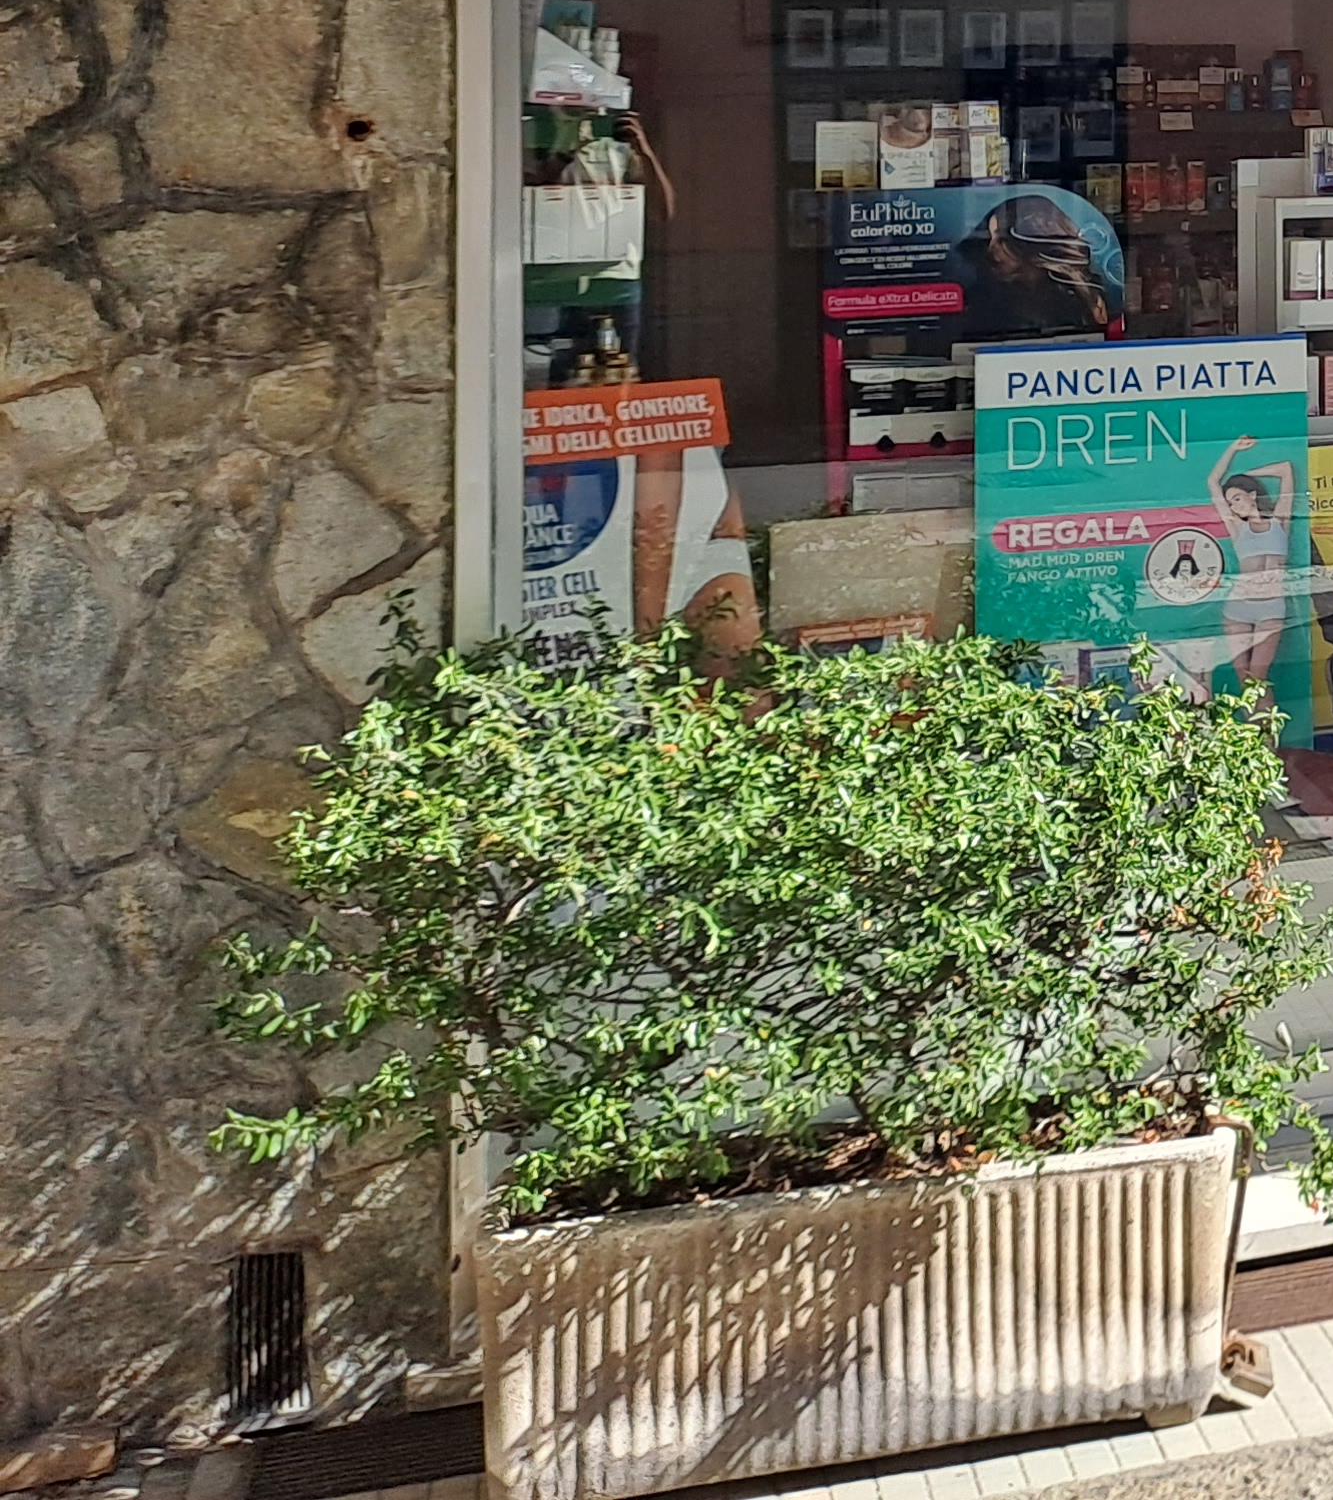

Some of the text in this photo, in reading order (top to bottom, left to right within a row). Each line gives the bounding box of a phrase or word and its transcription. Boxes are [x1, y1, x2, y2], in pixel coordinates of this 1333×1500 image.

[915, 222, 935, 235] XD
[828, 293, 877, 308] Formula
[912, 290, 959, 303] Delicata
[1006, 359, 1278, 400] PANCIA PIATTA
[615, 393, 716, 421] GONFIORE,
[556, 429, 613, 454] DELLA
[614, 419, 713, 448] CELLULITE?
[1006, 408, 1190, 473] DREN
[1313, 477, 1328, 490] Ti
[523, 523, 577, 549] ANCE
[1007, 515, 1150, 549] REGALA
[1008, 549, 1126, 570] MAD MUD DREN
[1007, 564, 1119, 585] FANGO ATTIVO
